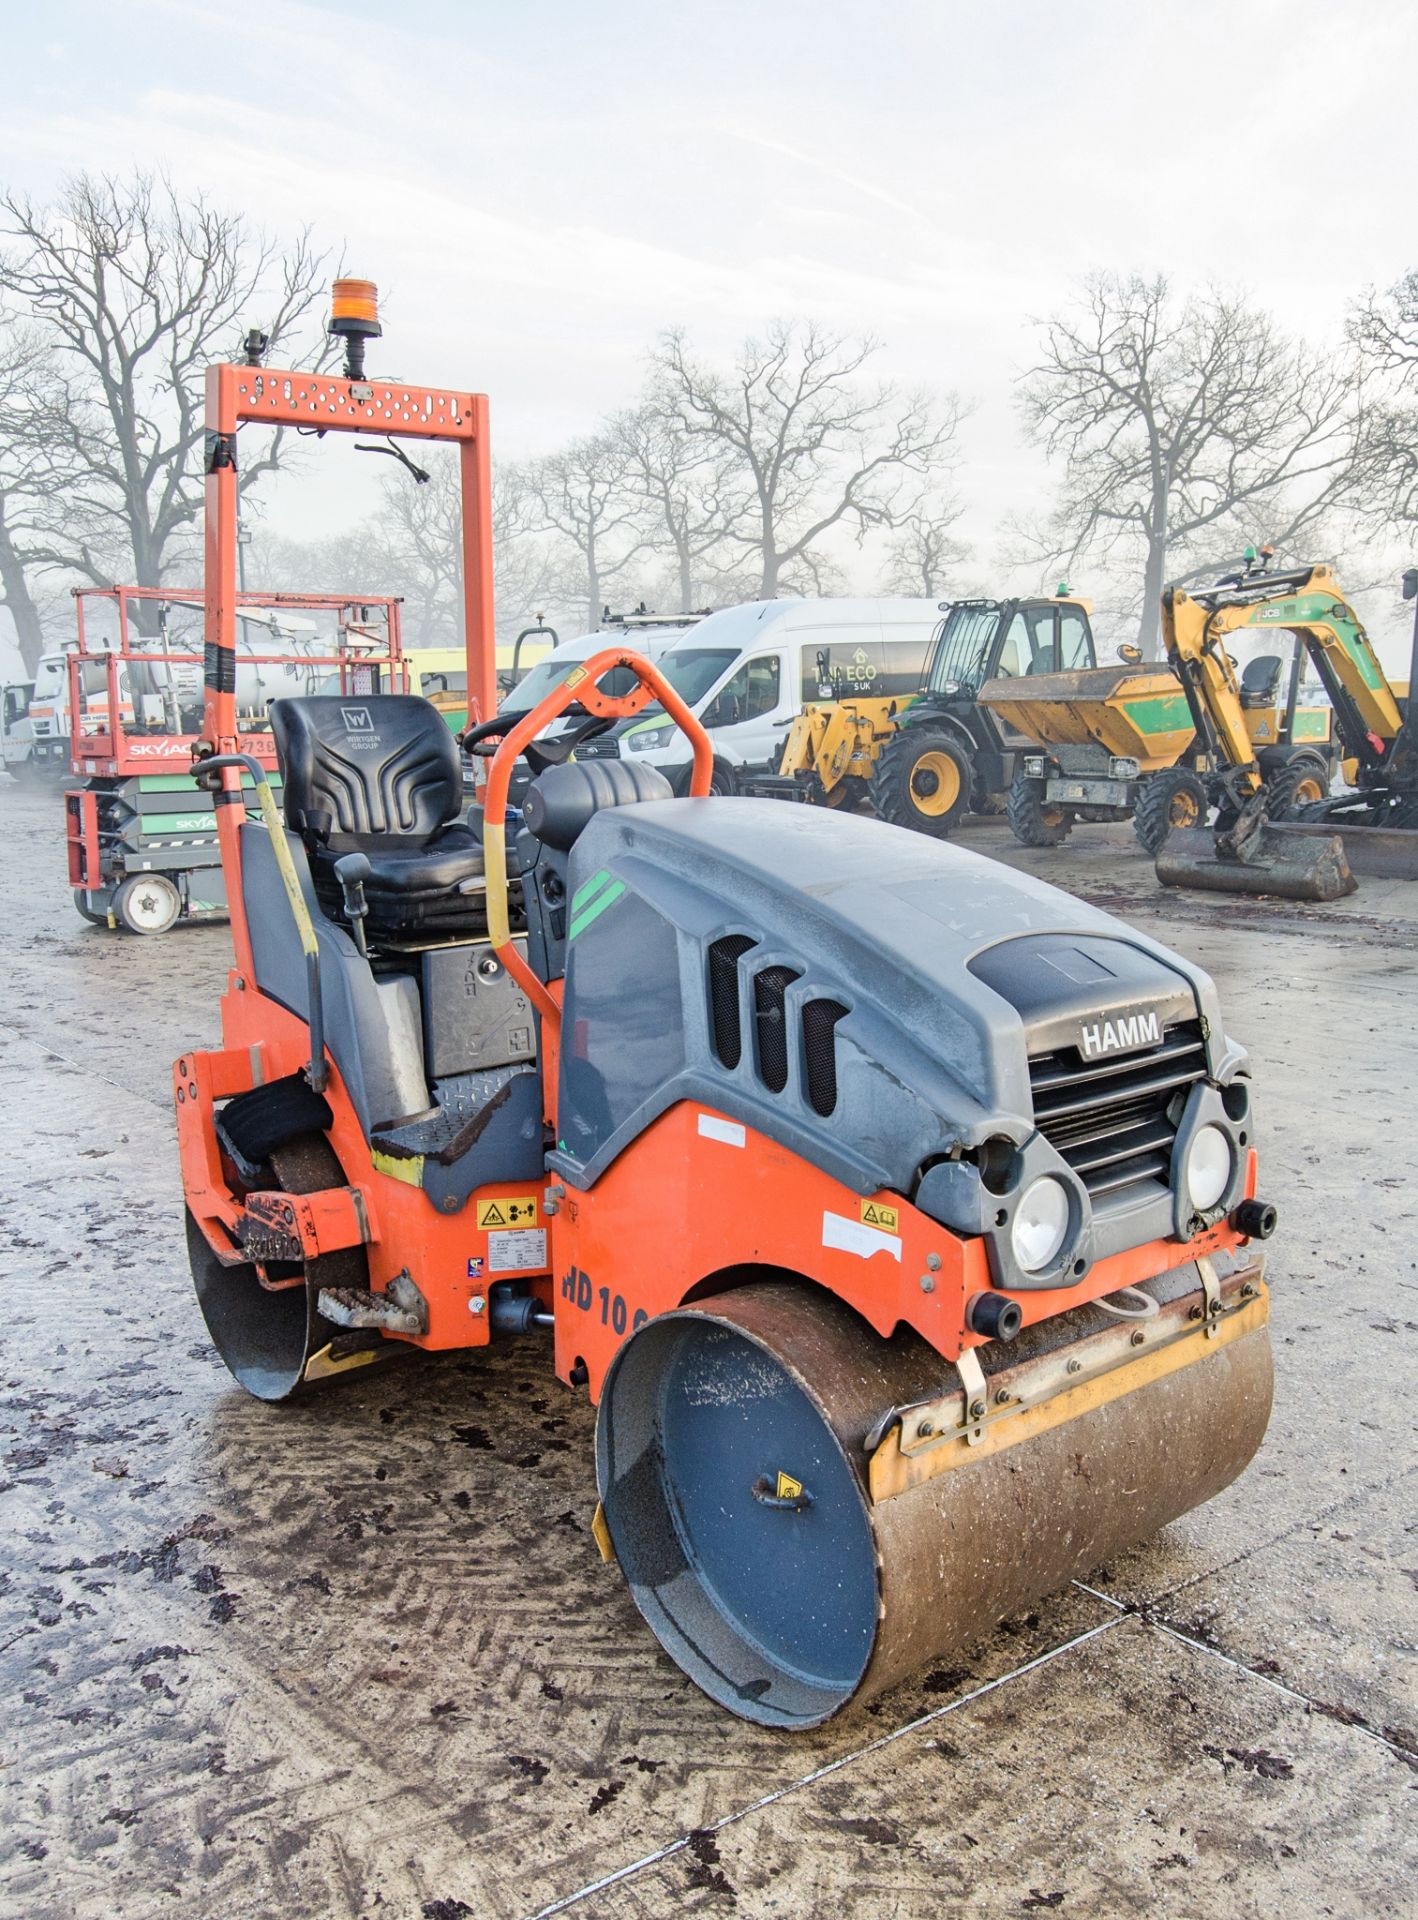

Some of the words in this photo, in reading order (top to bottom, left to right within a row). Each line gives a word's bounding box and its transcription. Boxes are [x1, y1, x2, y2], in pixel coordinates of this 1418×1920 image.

[1262, 608, 1280, 618] JCB
[846, 665, 877, 681] ECO
[346, 735, 382, 743] WIRTGEN
[351, 742, 378, 750] GROUP
[130, 739, 192, 756] SKYJAC
[176, 815, 217, 829] SKYJA
[1082, 1012, 1159, 1055] HAMM
[562, 1265, 592, 1312] HD
[599, 1287, 627, 1335] 10
